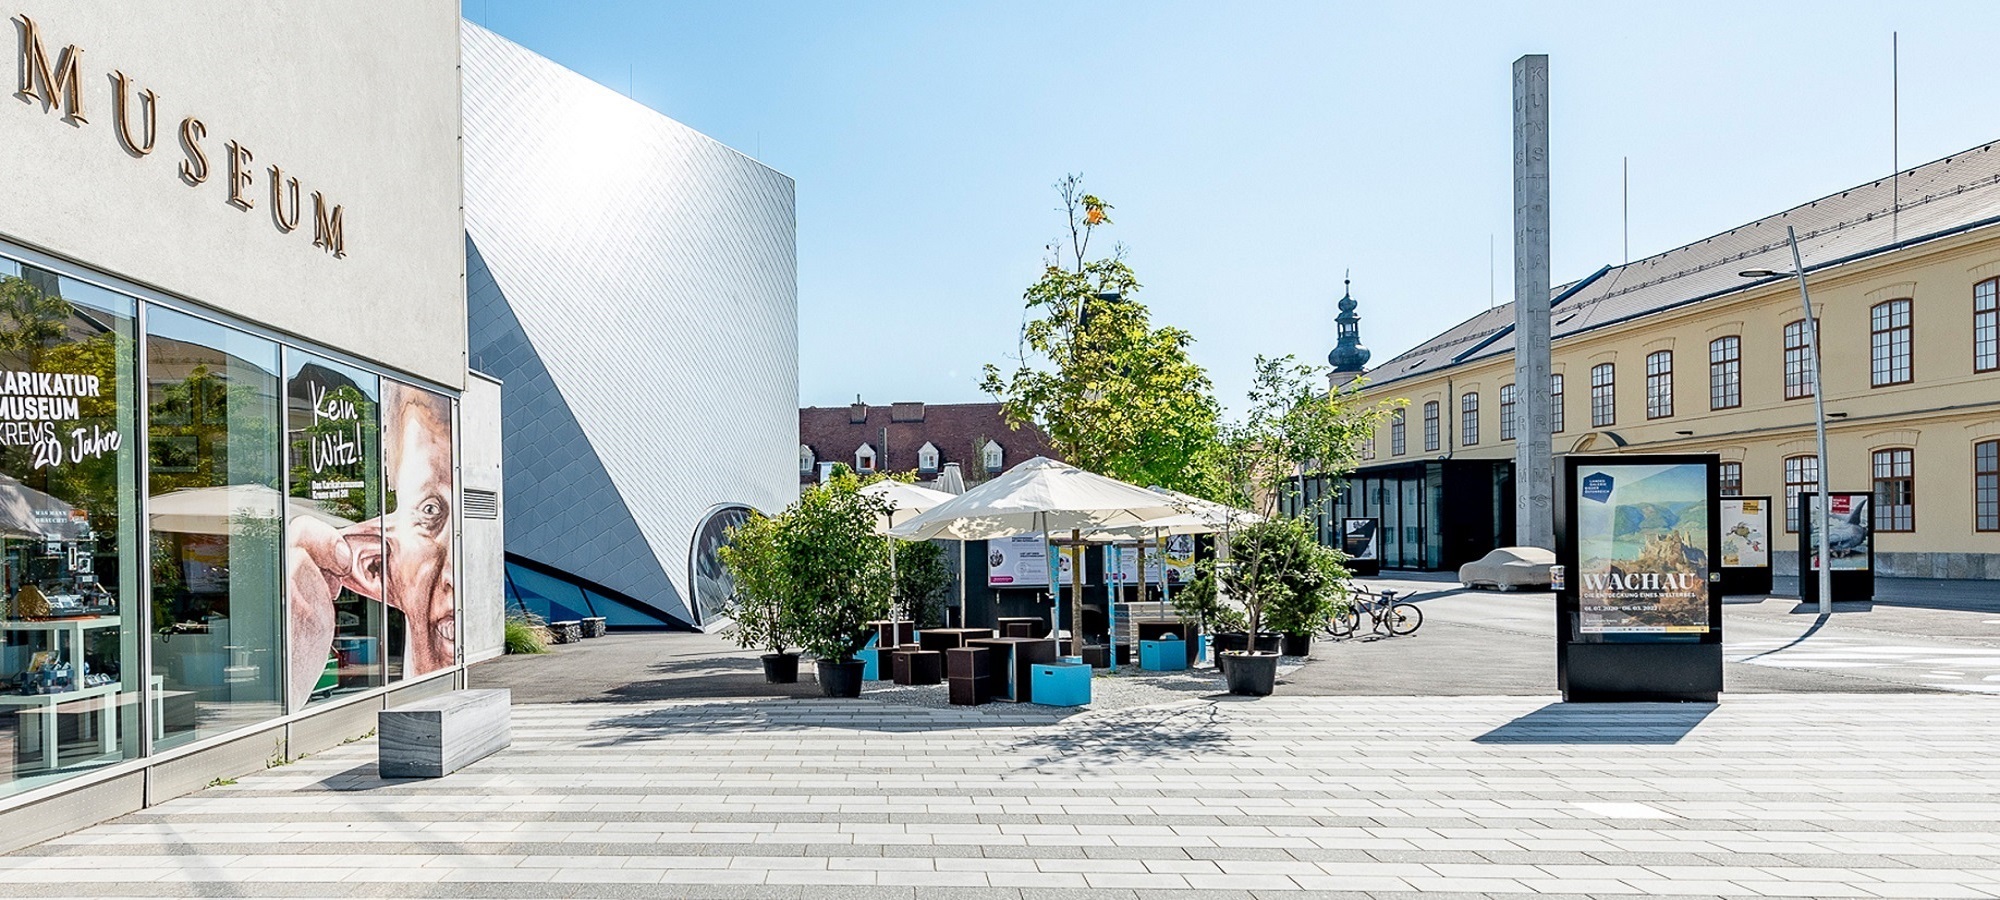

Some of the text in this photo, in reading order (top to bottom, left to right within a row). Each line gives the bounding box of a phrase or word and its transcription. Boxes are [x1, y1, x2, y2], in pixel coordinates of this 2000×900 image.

[18, 13, 347, 259] MUSEUM
[310, 380, 358, 427] Kein
[32, 424, 122, 470] 20 Jahre
[312, 422, 362, 474] Witz!
[1583, 573, 1695, 590] WACHAU
